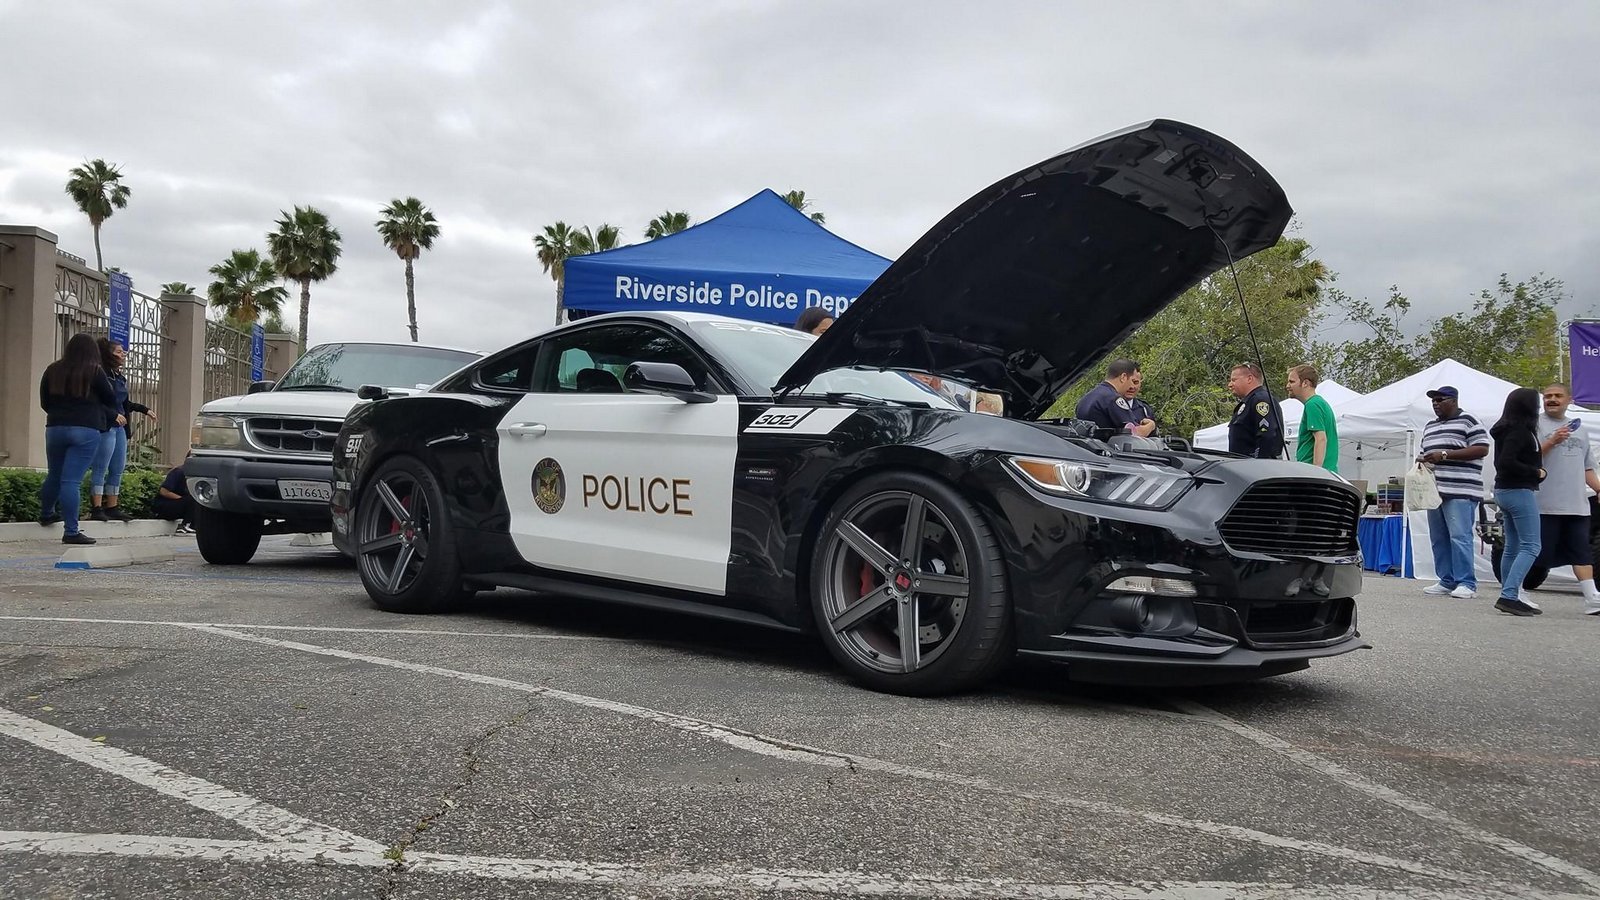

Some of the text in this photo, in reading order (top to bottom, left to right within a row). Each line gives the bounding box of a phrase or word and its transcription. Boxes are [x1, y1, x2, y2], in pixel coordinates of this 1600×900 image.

[615, 276, 723, 305] Riverside
[730, 283, 799, 310] Police
[1582, 345, 1600, 357] He
[754, 414, 799, 425] 302
[284, 488, 330, 500] 1176613
[582, 474, 694, 517] POLICE
